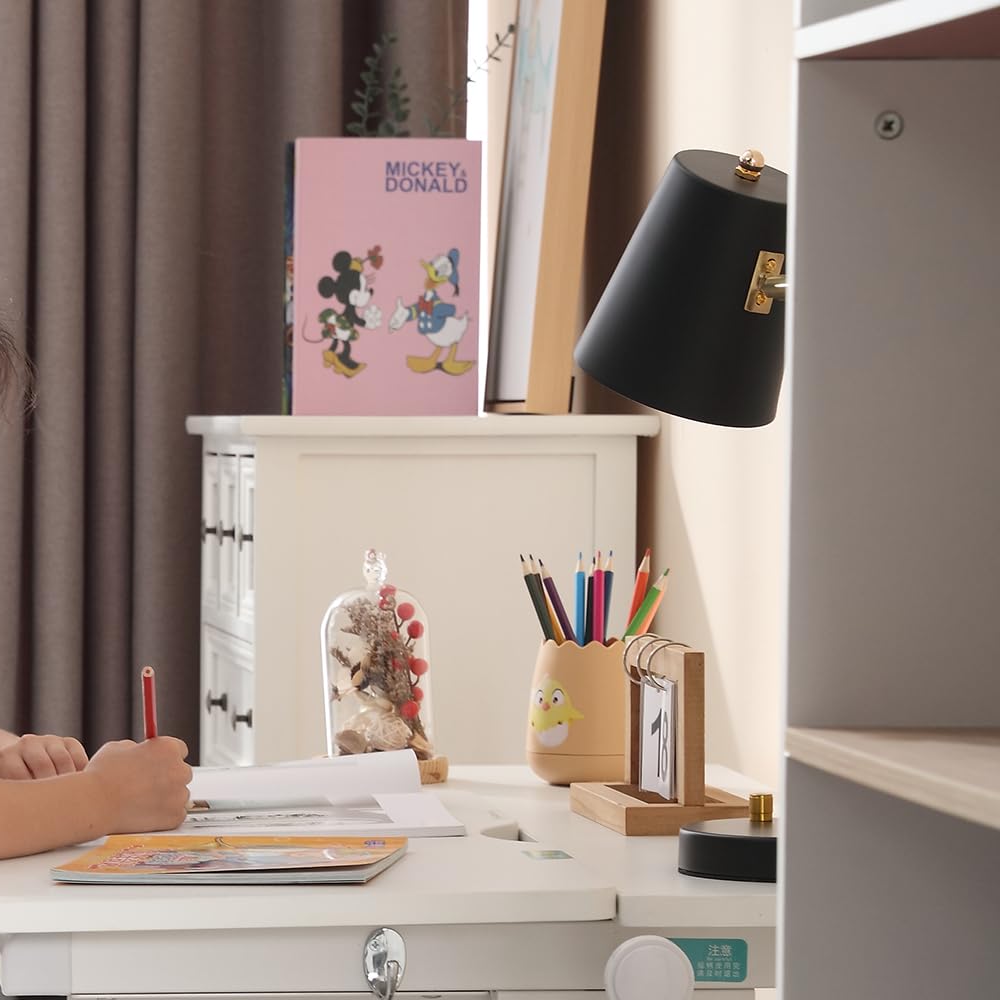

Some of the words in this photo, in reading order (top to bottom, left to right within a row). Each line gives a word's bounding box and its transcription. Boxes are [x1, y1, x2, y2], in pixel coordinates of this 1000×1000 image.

[385, 177, 467, 193] DONALD
[650, 708, 668, 782] 18
[708, 944, 733, 957] 注意
